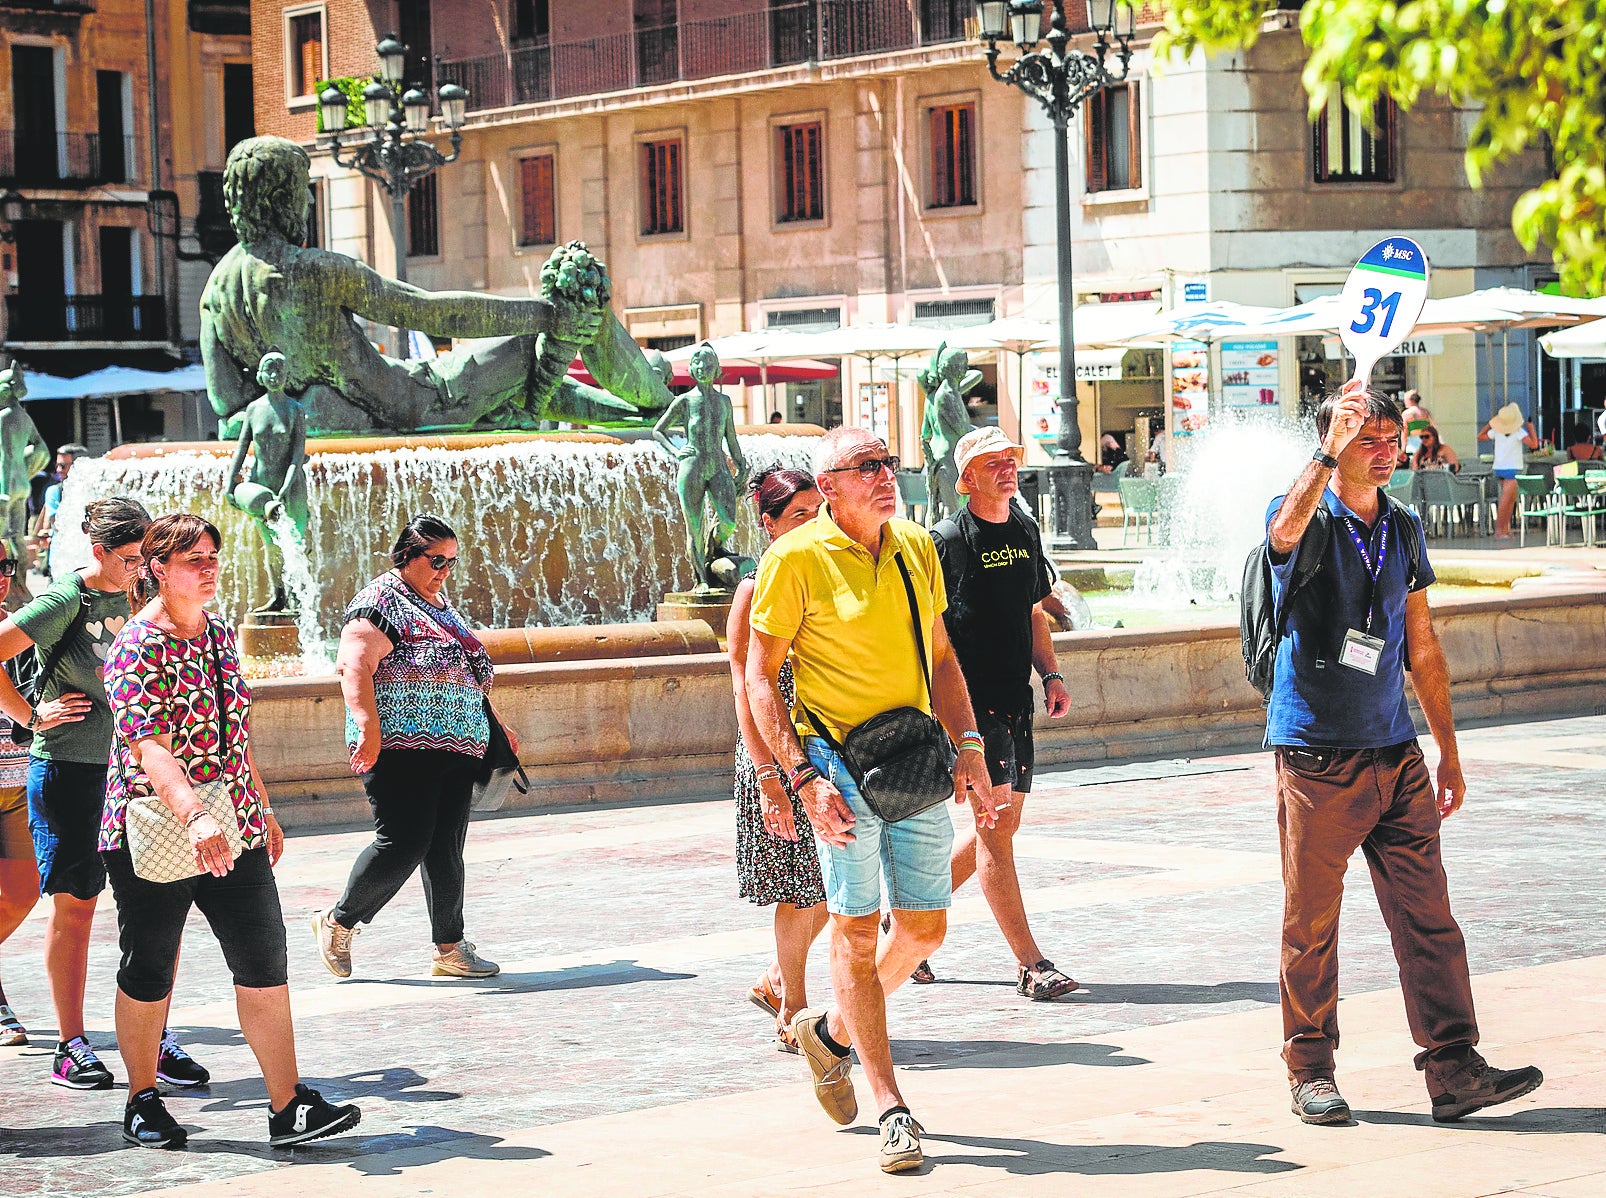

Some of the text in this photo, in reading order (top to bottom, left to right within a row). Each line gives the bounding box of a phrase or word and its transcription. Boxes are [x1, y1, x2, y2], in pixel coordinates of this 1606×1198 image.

[1394, 249, 1414, 261] MSC
[1350, 287, 1402, 338] 31
[1046, 365, 1112, 378] EL CALET
[1344, 517, 1355, 534] ITALI
